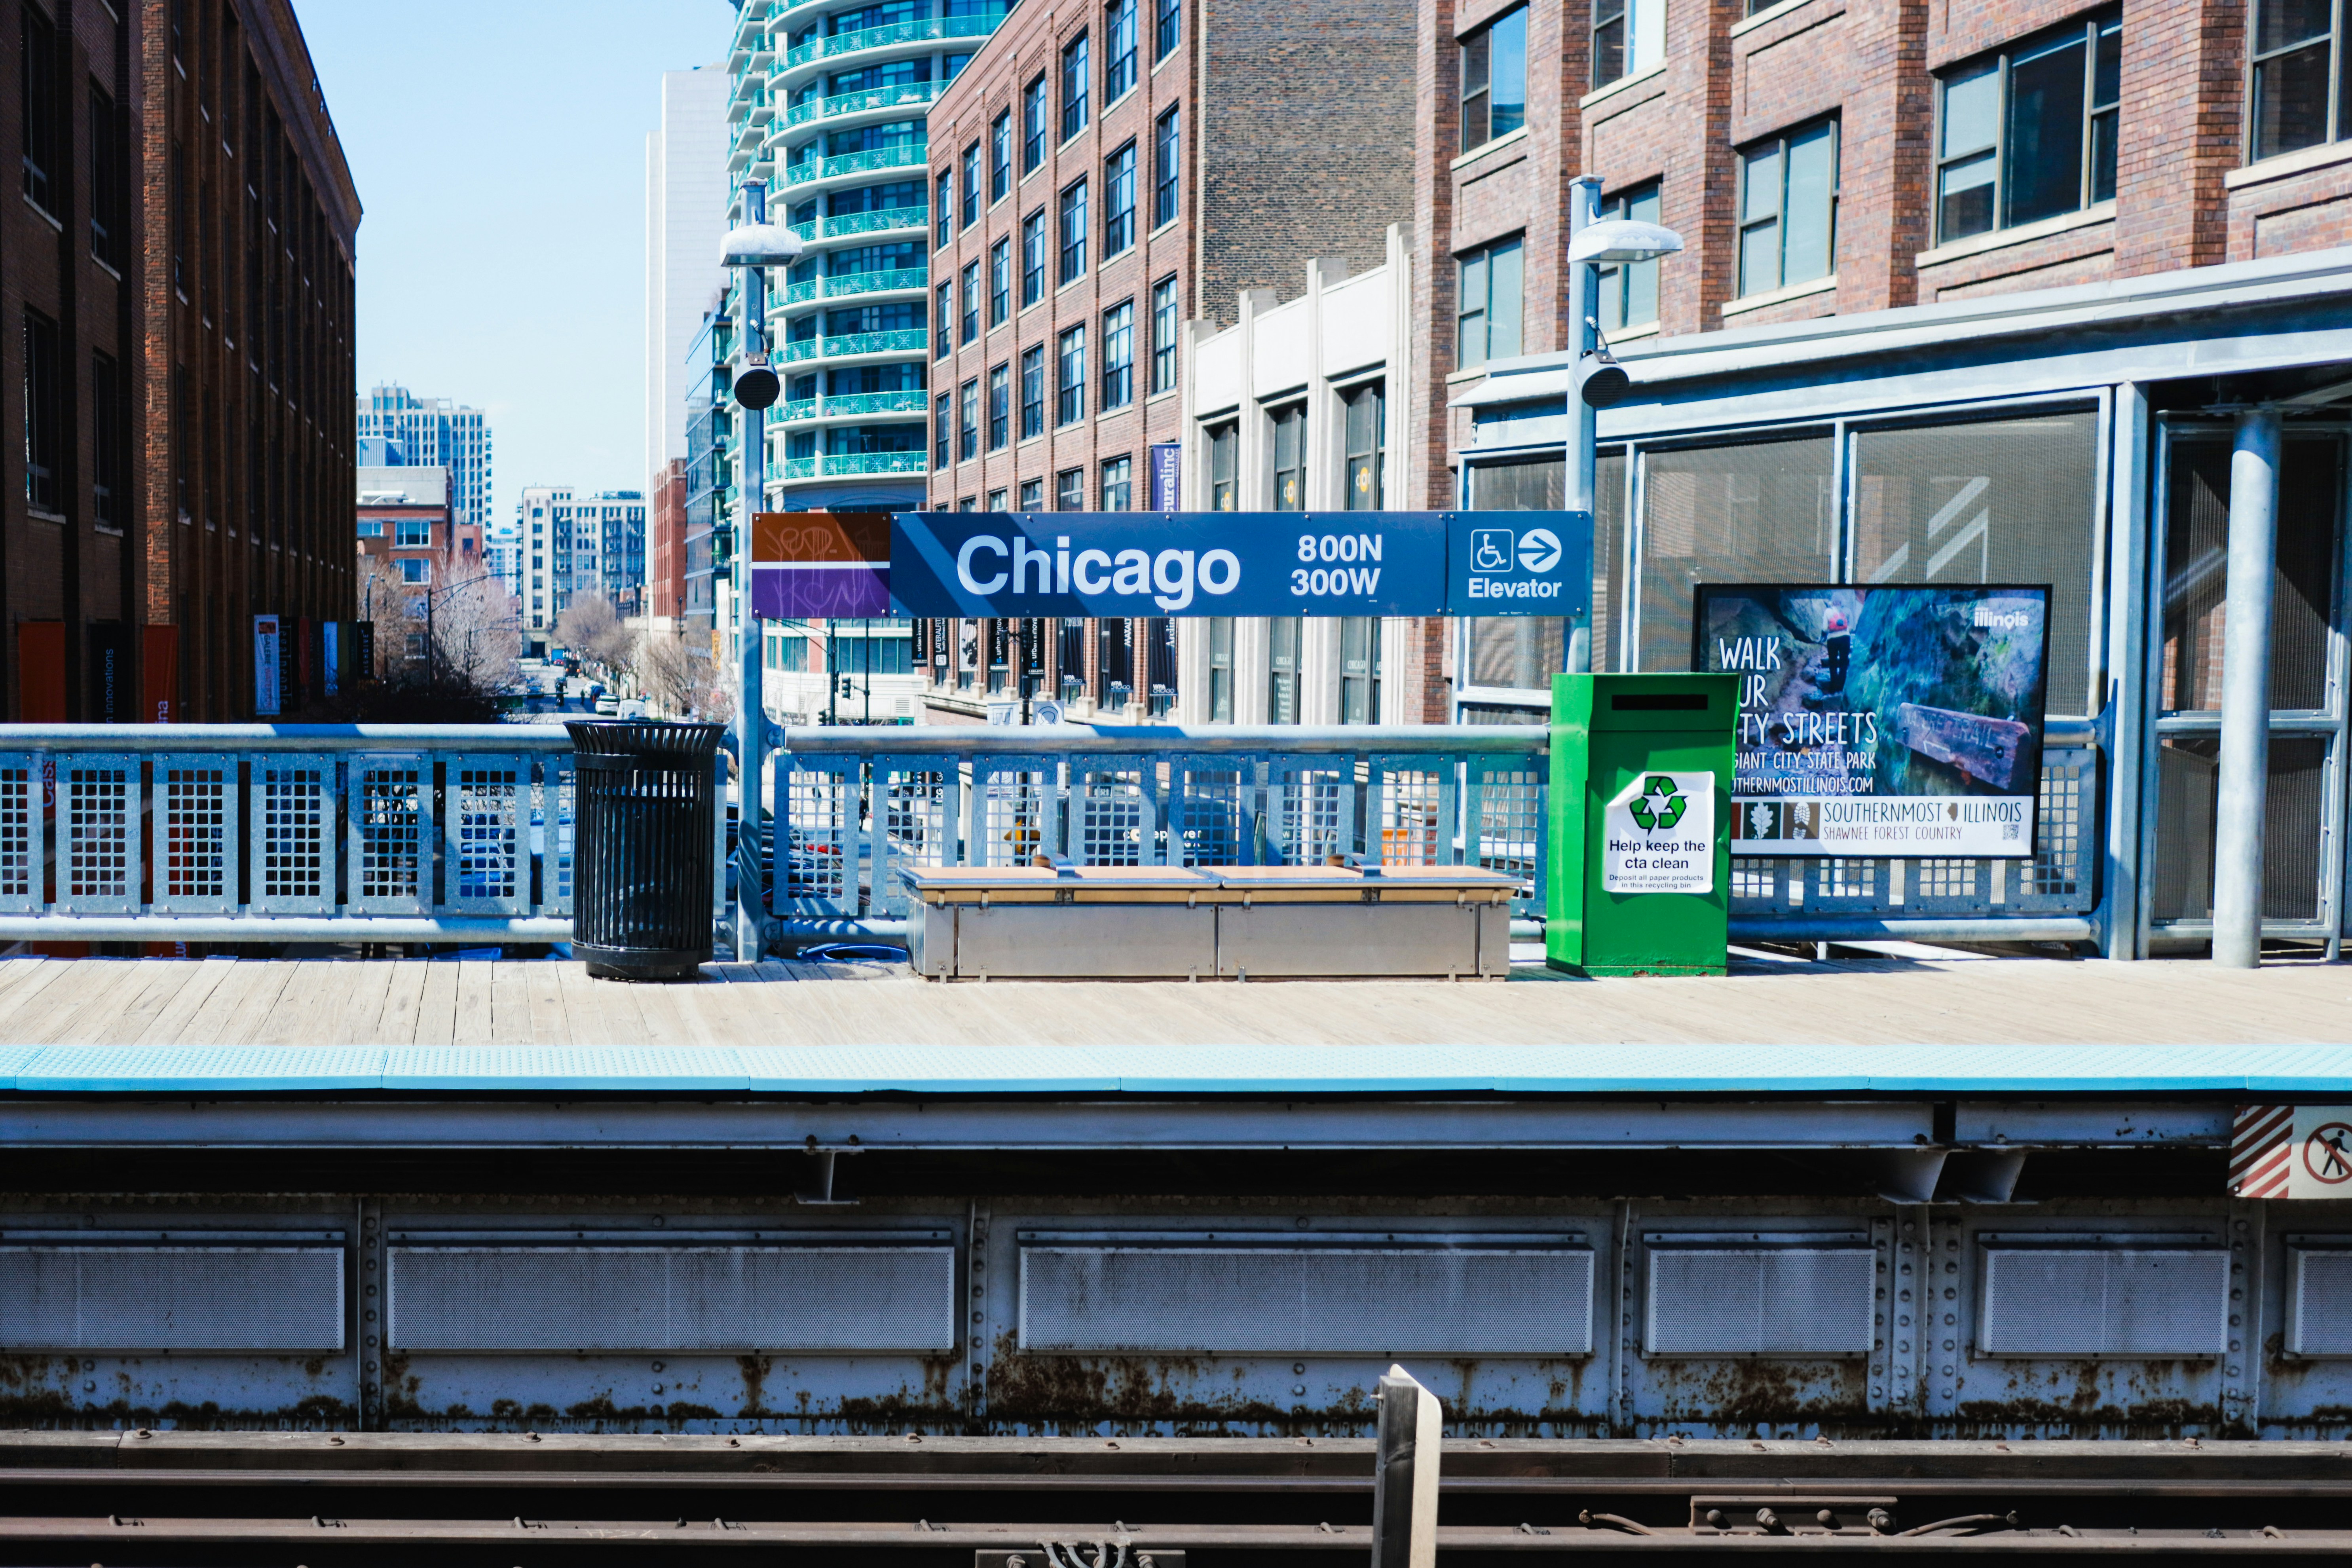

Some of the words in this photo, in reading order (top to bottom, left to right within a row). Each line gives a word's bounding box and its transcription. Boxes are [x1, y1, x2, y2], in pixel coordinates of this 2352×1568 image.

[1160, 448, 1175, 512] curalinc
[1298, 534, 1382, 562] 800N
[957, 535, 1240, 610] Chicago
[1291, 568, 1381, 596] 300W
[1468, 578, 1562, 598] Elevator
[1974, 611, 2029, 630] illinois
[1719, 636, 1781, 670] WALK
[1347, 660, 1366, 670] CHICAGO
[106, 648, 114, 713] innovations
[1739, 712, 1770, 745] TY
[1782, 712, 1877, 745] STREETS
[1773, 752, 1801, 769] CITY
[1807, 752, 1840, 769] STATE
[1846, 751, 1876, 769] PARK
[1824, 802, 1943, 823] SOUTHERNMOST
[1964, 801, 2022, 823] ILLINOIS
[1824, 826, 1868, 840] SHAWNEE
[1874, 826, 1912, 840] FOREST
[1915, 826, 1962, 840] COUNTRY
[1609, 839, 1641, 854] Help
[1646, 839, 1679, 854] keep
[1684, 840, 1705, 852] the
[1625, 858, 1647, 869] cta
[1653, 858, 1688, 869] clean
